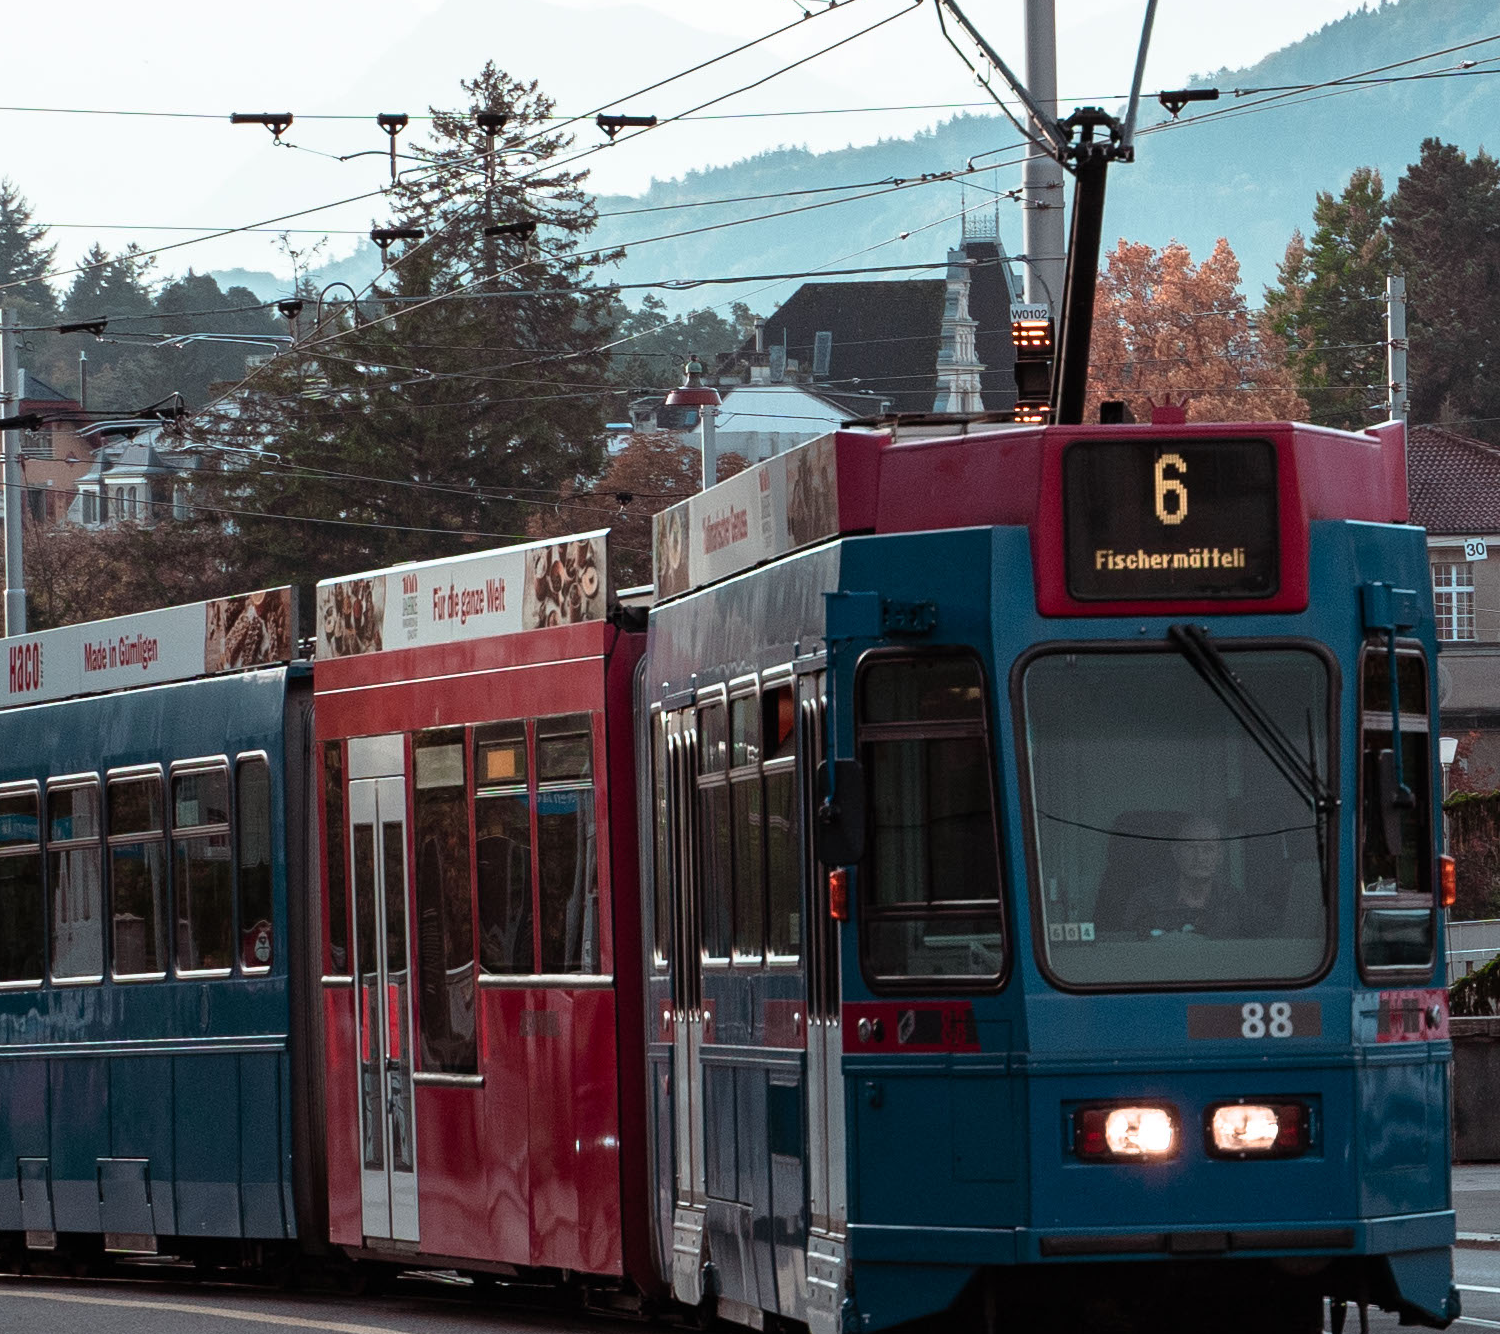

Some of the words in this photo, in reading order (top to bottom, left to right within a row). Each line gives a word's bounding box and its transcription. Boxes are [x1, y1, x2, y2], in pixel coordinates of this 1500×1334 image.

[1011, 309, 1048, 319] W0102
[1155, 454, 1188, 525] 6
[1096, 548, 1246, 570] Fischermätteli
[1467, 542, 1485, 556] 30
[433, 586, 446, 621] Für
[448, 584, 460, 619] die
[461, 588, 485, 625] ganze
[486, 577, 506, 614] Welt
[84, 640, 107, 672] Made
[109, 638, 117, 668] in
[119, 633, 158, 670] Gümligen
[1240, 1001, 1294, 1038] 88
